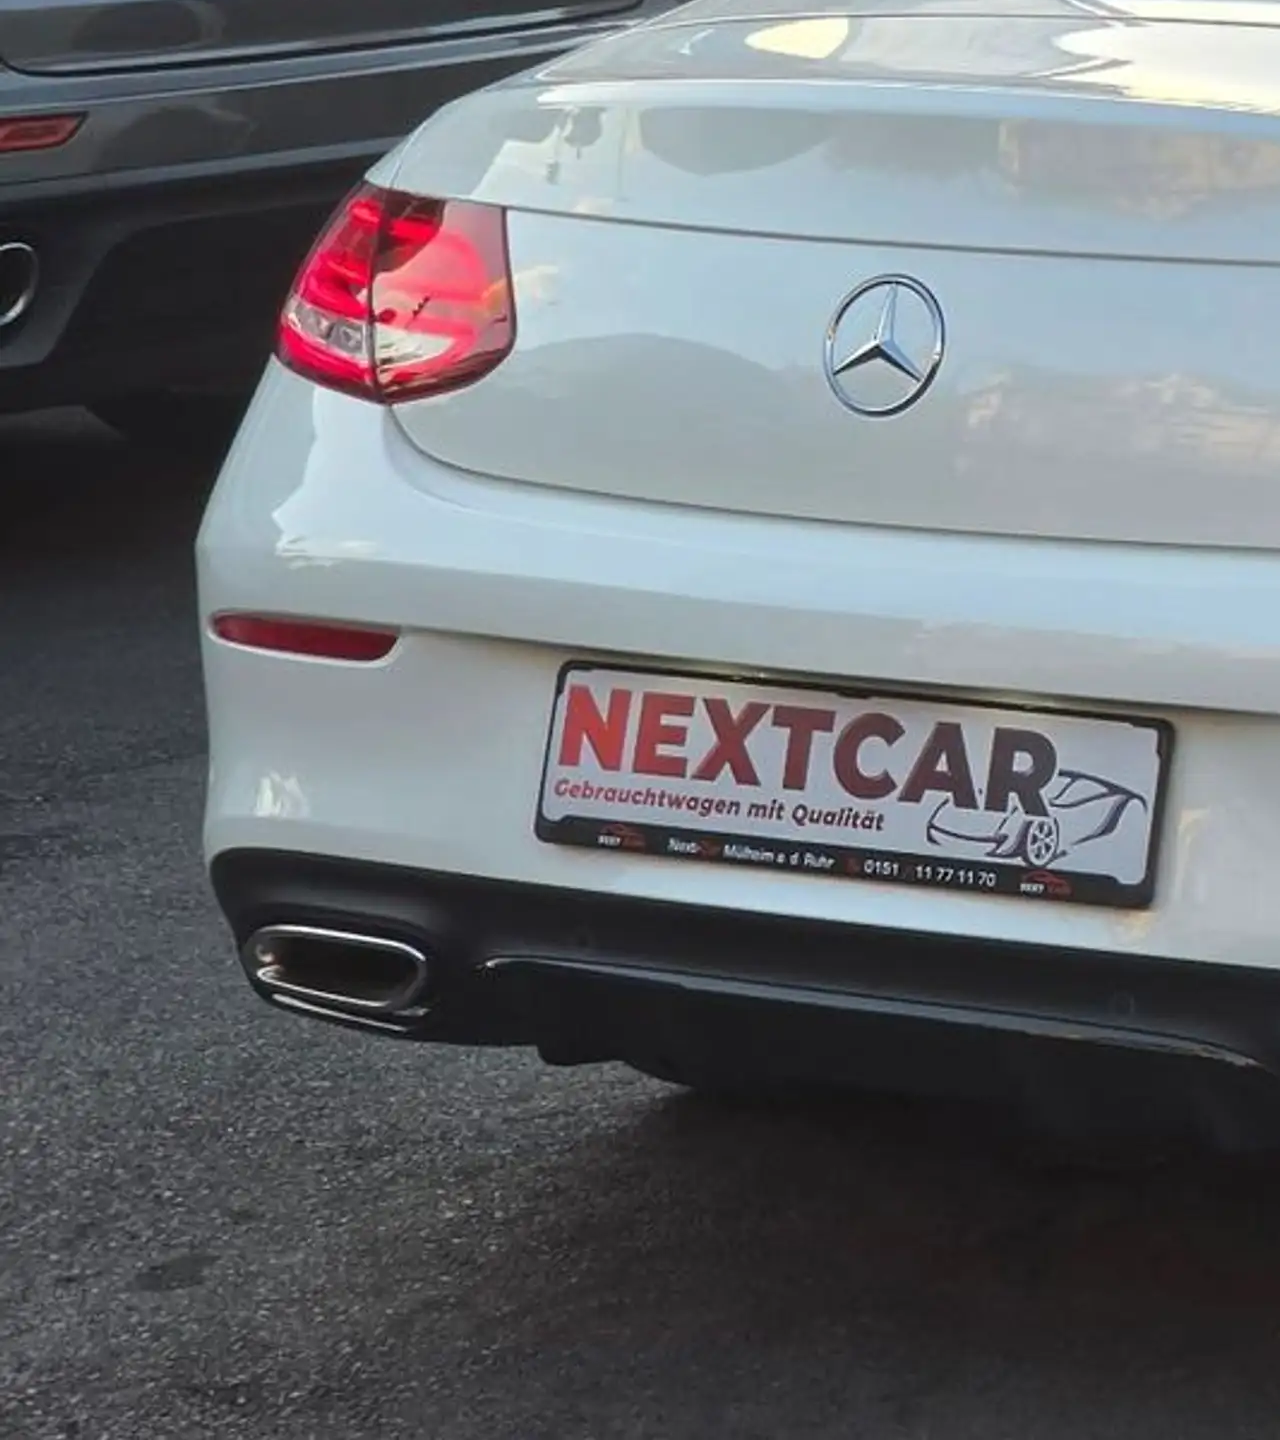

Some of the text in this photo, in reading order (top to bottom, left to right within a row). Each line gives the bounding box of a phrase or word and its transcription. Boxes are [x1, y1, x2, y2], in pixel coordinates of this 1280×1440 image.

[557, 682, 1058, 818] NEXTCAR
[553, 777, 885, 833] Gebrauchtwagen mit Qualität
[863, 859, 900, 877] 0151
